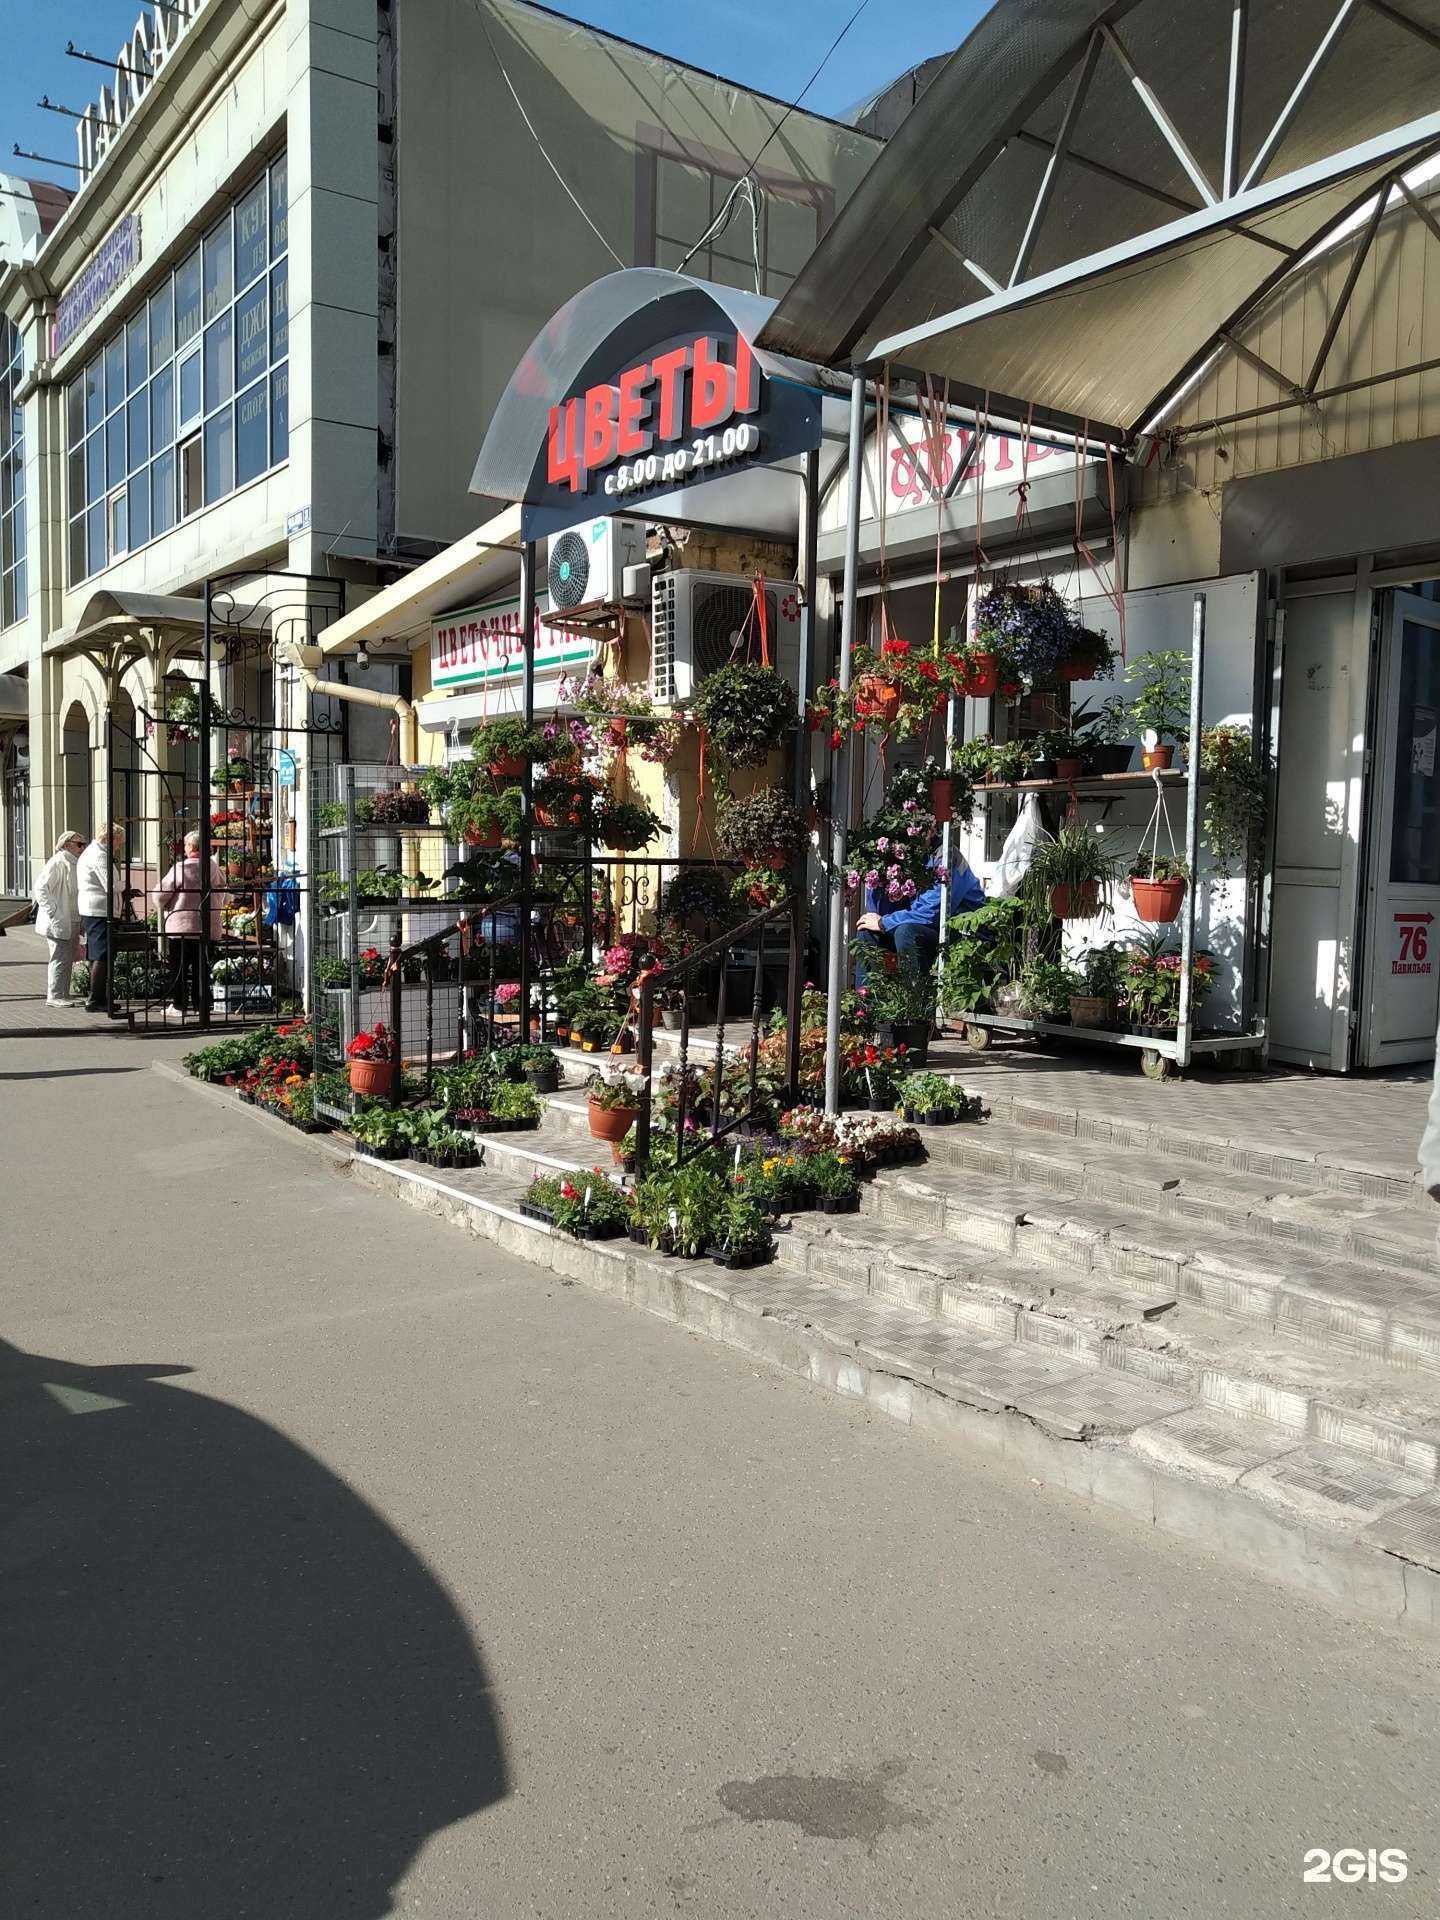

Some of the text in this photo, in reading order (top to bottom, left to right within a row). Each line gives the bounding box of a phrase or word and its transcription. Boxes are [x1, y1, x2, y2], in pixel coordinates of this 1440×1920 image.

[547, 331, 755, 493] ЦВЕТЫ
[605, 423, 751, 496] с 8.00 до 21.00
[1400, 927, 1427, 961] 76
